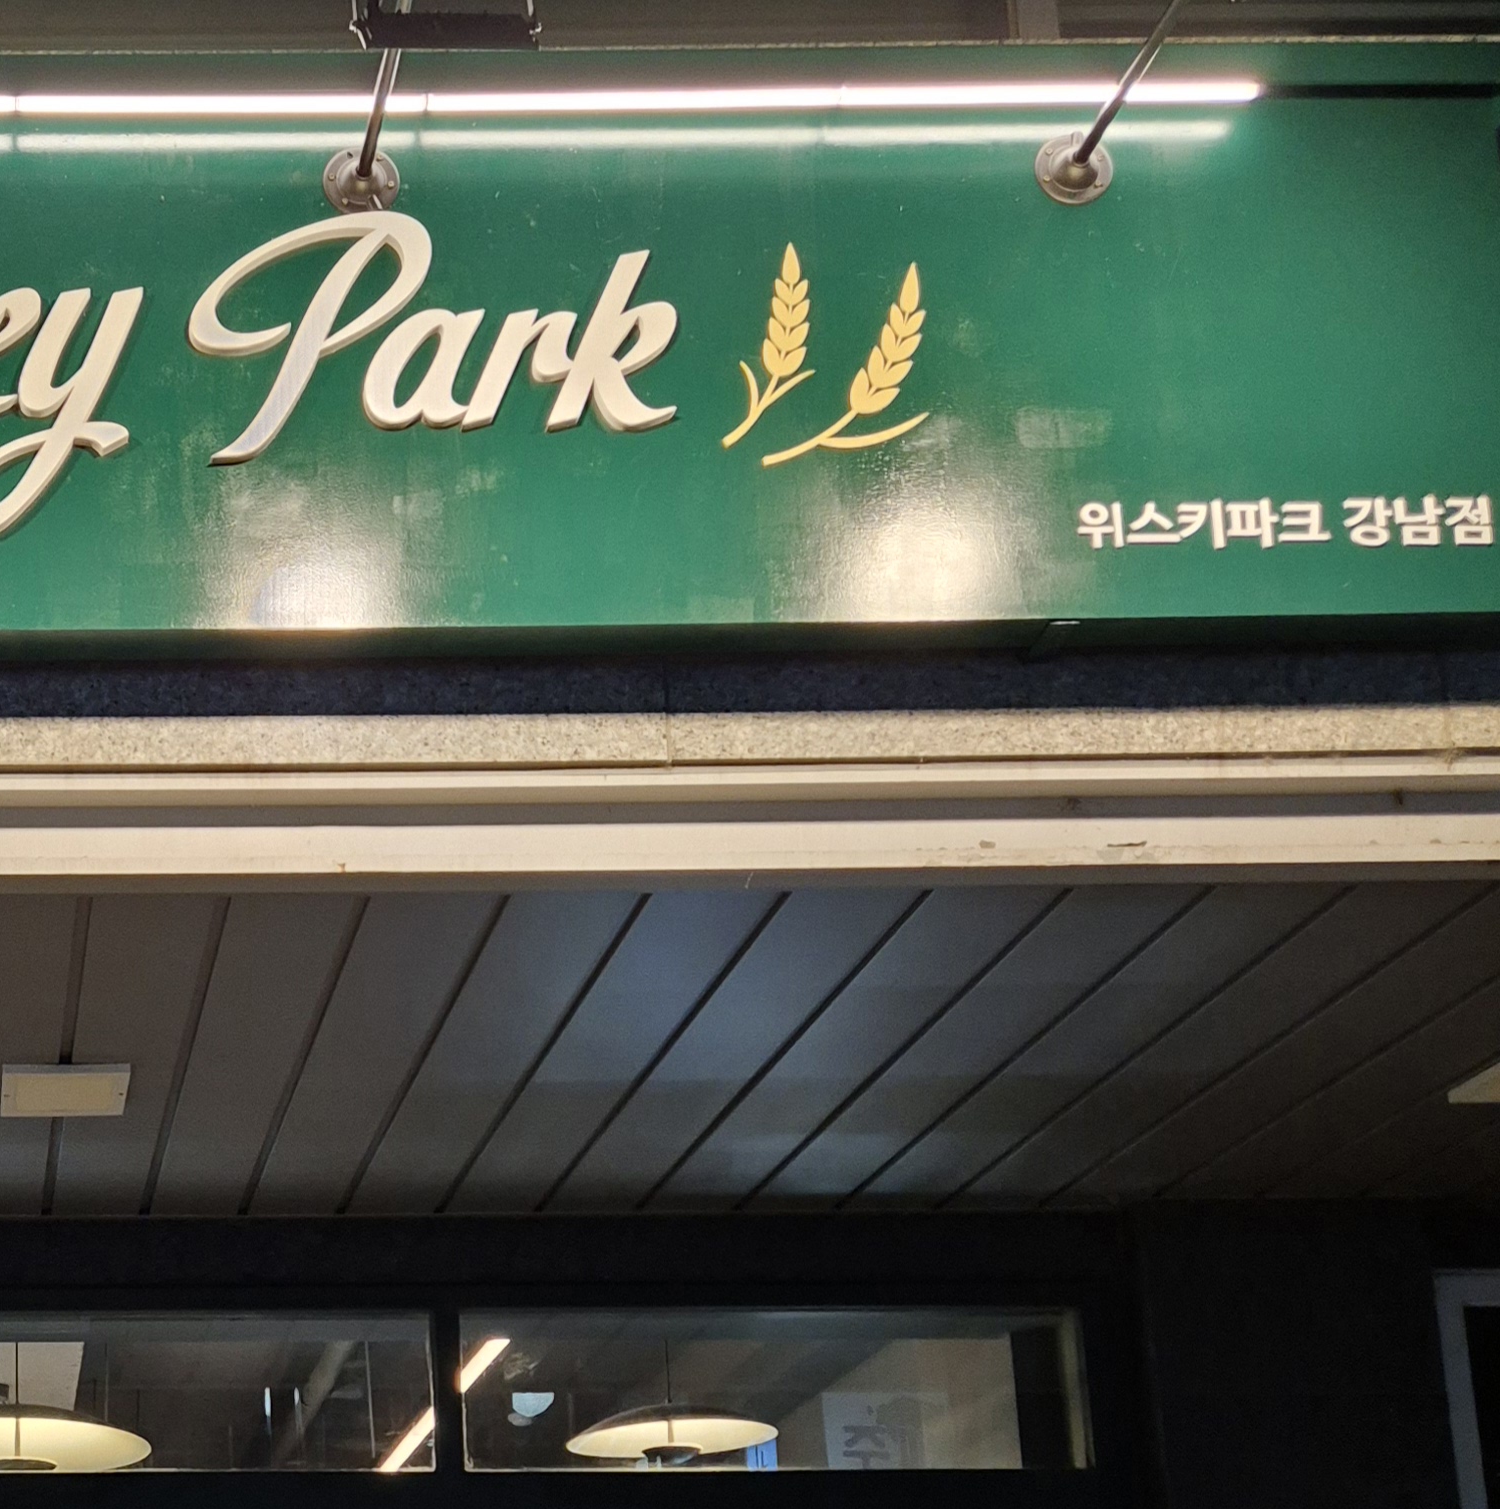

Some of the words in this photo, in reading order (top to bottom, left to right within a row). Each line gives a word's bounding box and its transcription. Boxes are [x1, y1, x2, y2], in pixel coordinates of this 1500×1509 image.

[188, 210, 678, 466] Park
[1077, 497, 1331, 550] 위스키파크
[1342, 493, 1494, 547] 강남점
